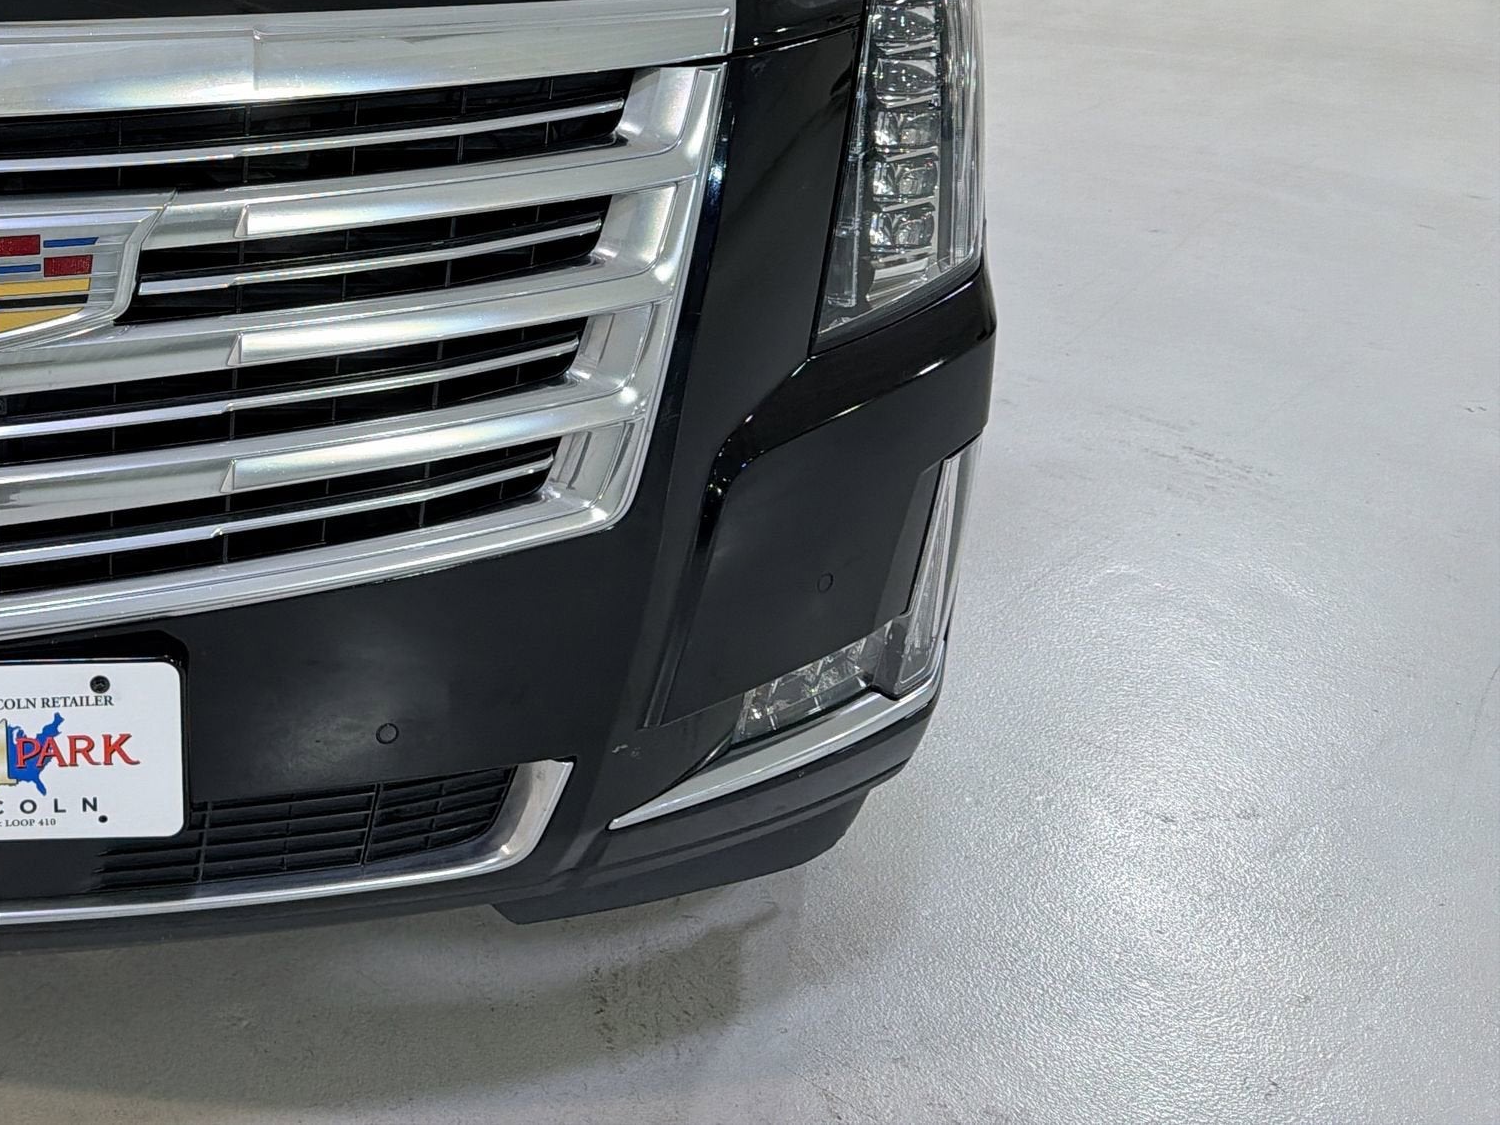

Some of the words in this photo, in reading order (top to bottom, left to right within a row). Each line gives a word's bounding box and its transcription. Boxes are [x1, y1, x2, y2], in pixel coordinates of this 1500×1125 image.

[41, 695, 114, 709] RETAILER
[15, 733, 141, 770] PARK
[5, 818, 35, 827] LOOP
[38, 818, 57, 827] 410
